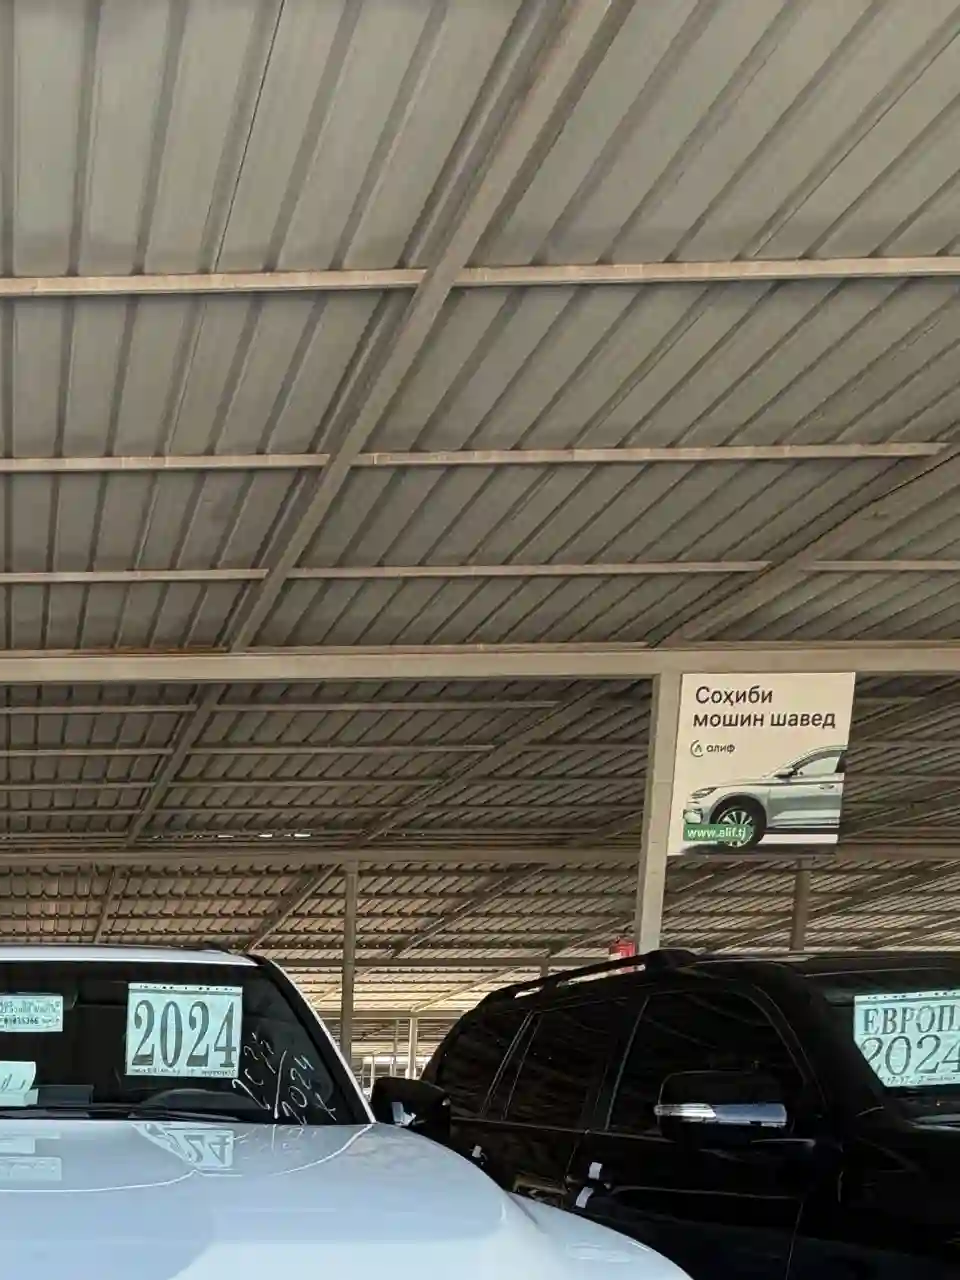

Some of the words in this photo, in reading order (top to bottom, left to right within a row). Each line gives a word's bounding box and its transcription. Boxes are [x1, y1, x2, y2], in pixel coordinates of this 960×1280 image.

[695, 685, 773, 708] Соҳиби
[692, 711, 764, 728] мошин
[769, 711, 836, 729] шавед
[706, 743, 736, 754] алиф
[687, 826, 747, 841] www.alif.tj
[860, 1004, 960, 1036] ЕВРОП
[131, 999, 237, 1068] 2024
[861, 1034, 960, 1076] 2024
